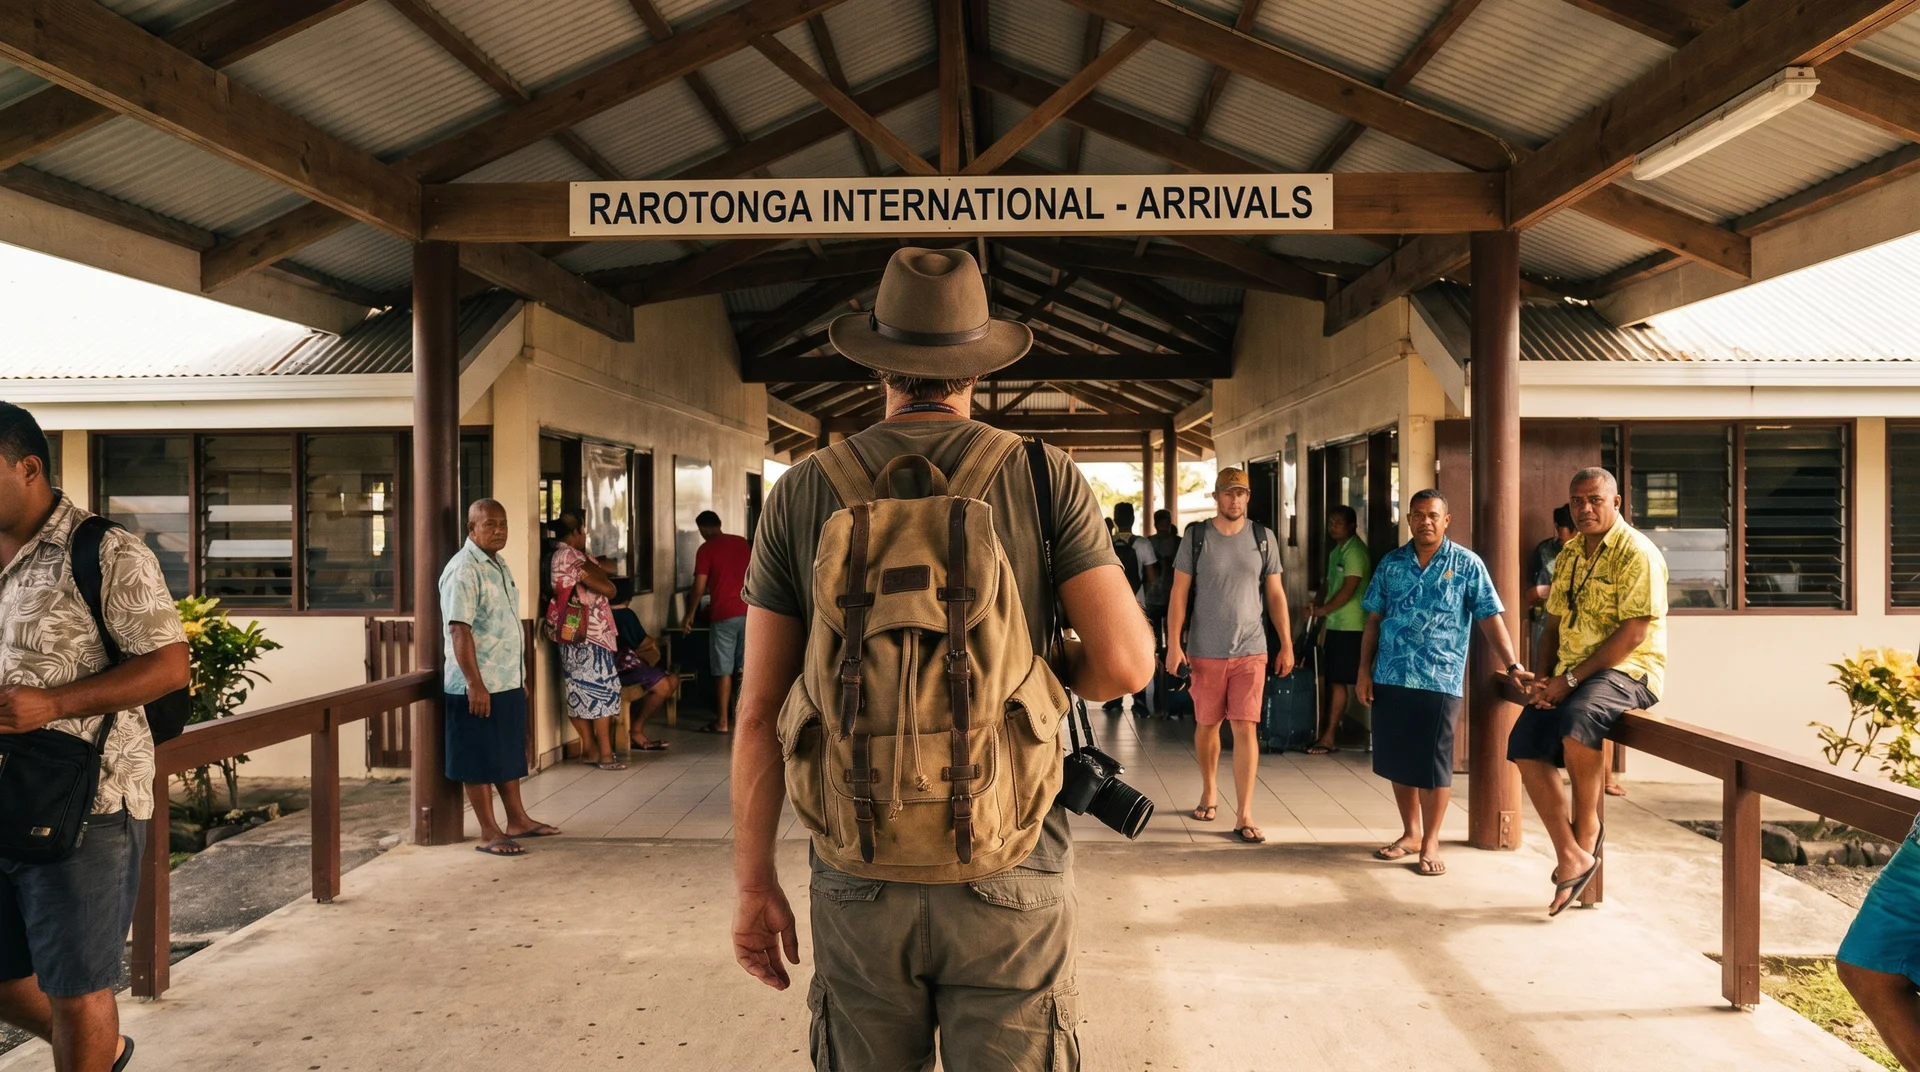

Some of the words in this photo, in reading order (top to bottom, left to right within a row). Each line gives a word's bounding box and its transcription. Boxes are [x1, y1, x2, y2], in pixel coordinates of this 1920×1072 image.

[589, 189, 813, 225] RAROTONGA
[823, 187, 1105, 222] INTERNATIONAL
[1135, 185, 1313, 220] ARRIVALS
